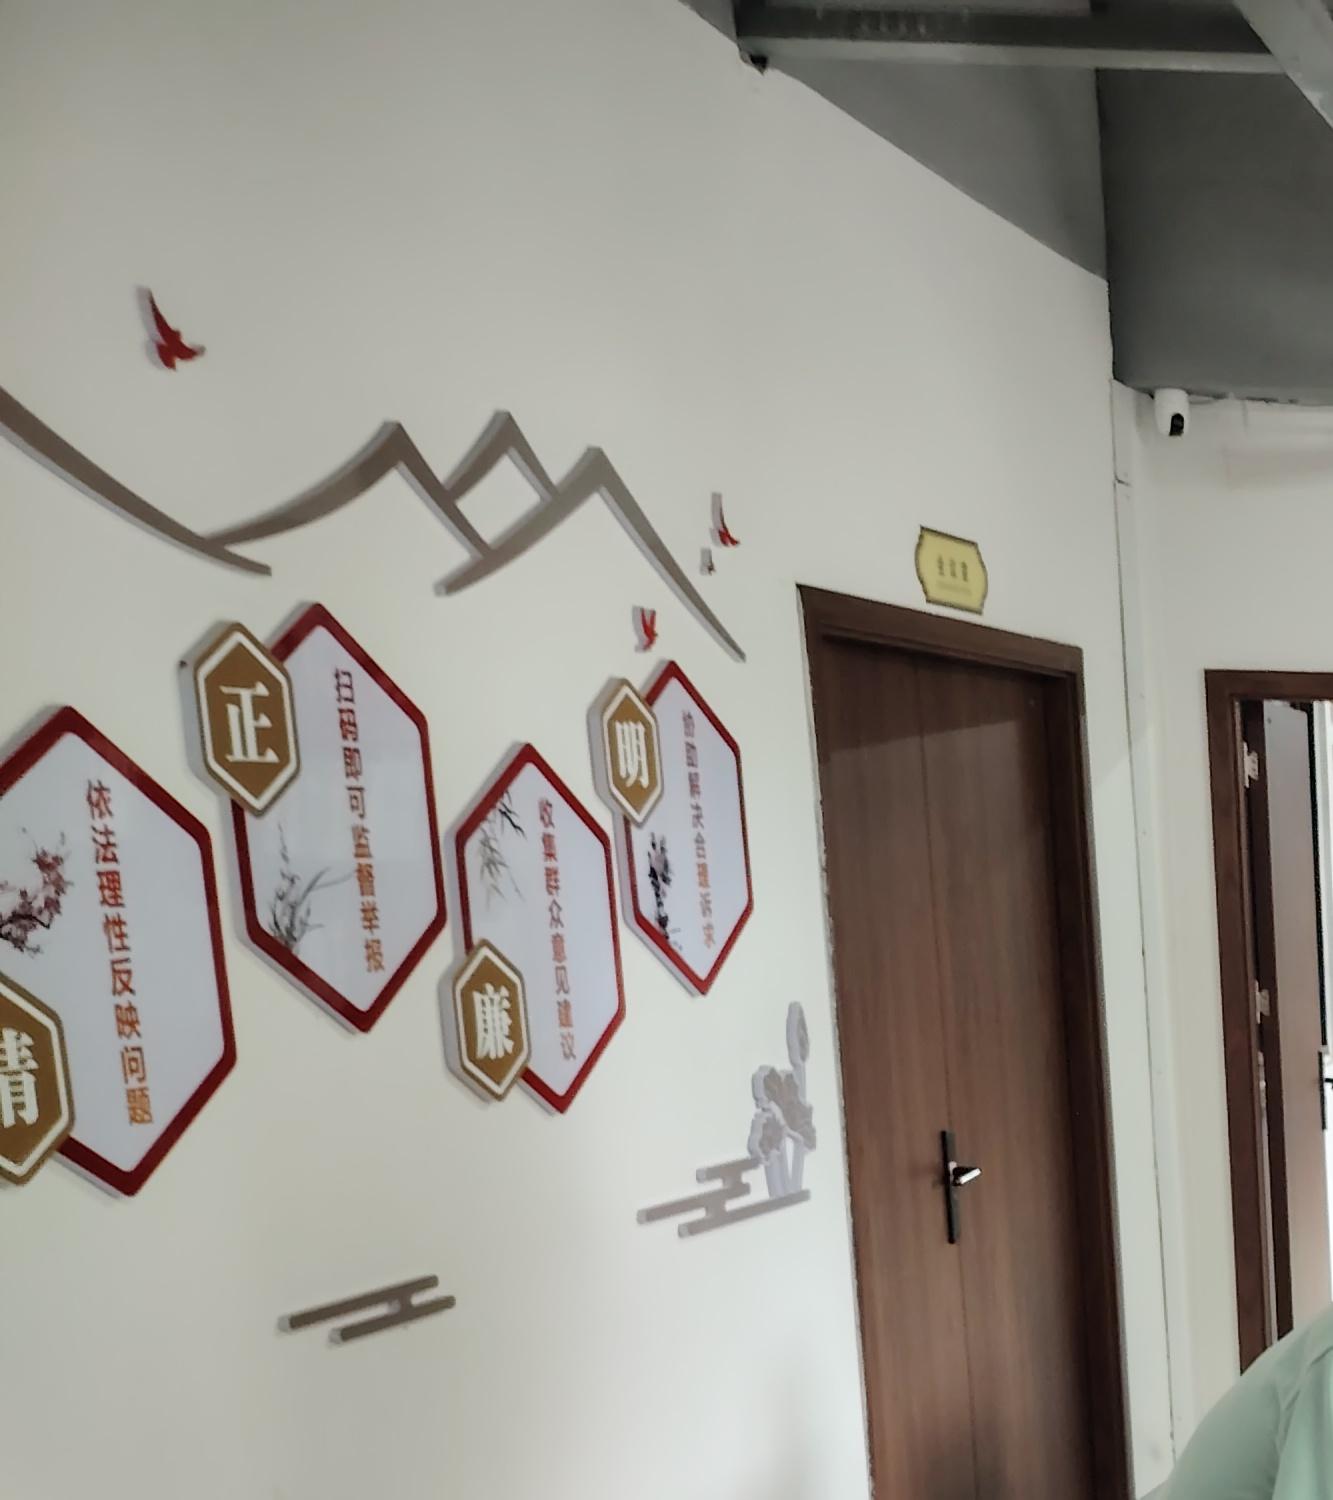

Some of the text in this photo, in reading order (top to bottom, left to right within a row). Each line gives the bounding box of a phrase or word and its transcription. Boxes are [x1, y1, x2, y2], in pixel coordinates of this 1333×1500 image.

[219, 681, 280, 764] 正
[614, 719, 649, 789] 明
[86, 779, 154, 1125] 依法理性反映问题
[537, 796, 577, 1061] 收集群众意见建议
[472, 982, 514, 1060] 廉
